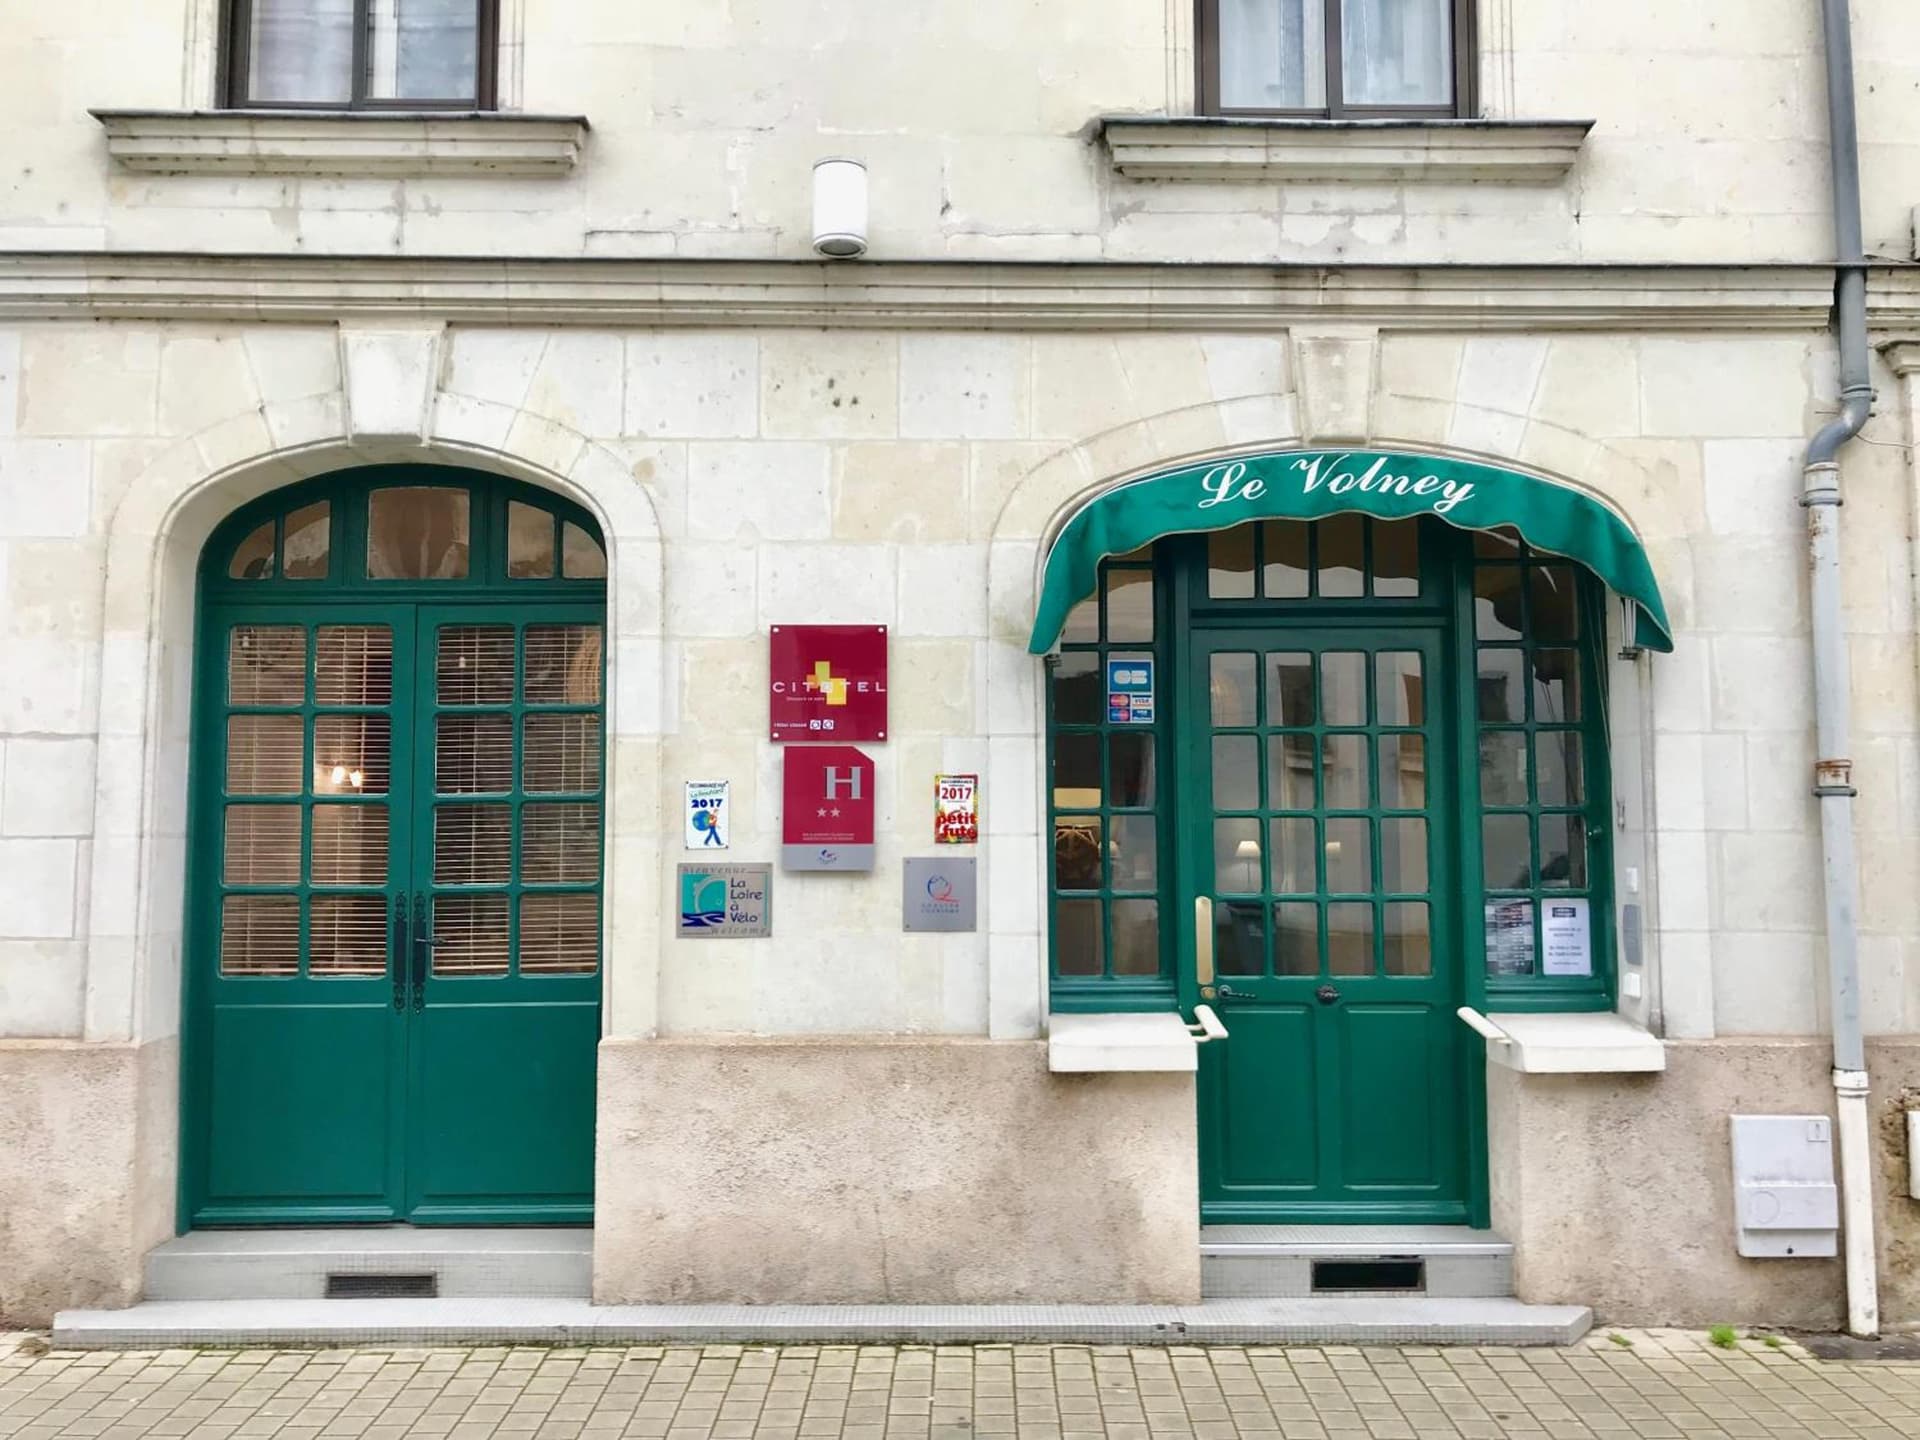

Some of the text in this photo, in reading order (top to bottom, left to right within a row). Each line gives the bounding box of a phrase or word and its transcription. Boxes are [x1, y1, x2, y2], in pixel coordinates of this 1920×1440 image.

[1198, 453, 1475, 513] Le Volney
[823, 766, 865, 800] H
[941, 787, 972, 799] 2017
[691, 798, 723, 808] 2017
[935, 811, 978, 828] petit
[730, 877, 746, 888] La
[730, 889, 763, 900] Loire
[730, 901, 739, 911] à
[730, 912, 758, 923] Vélo
